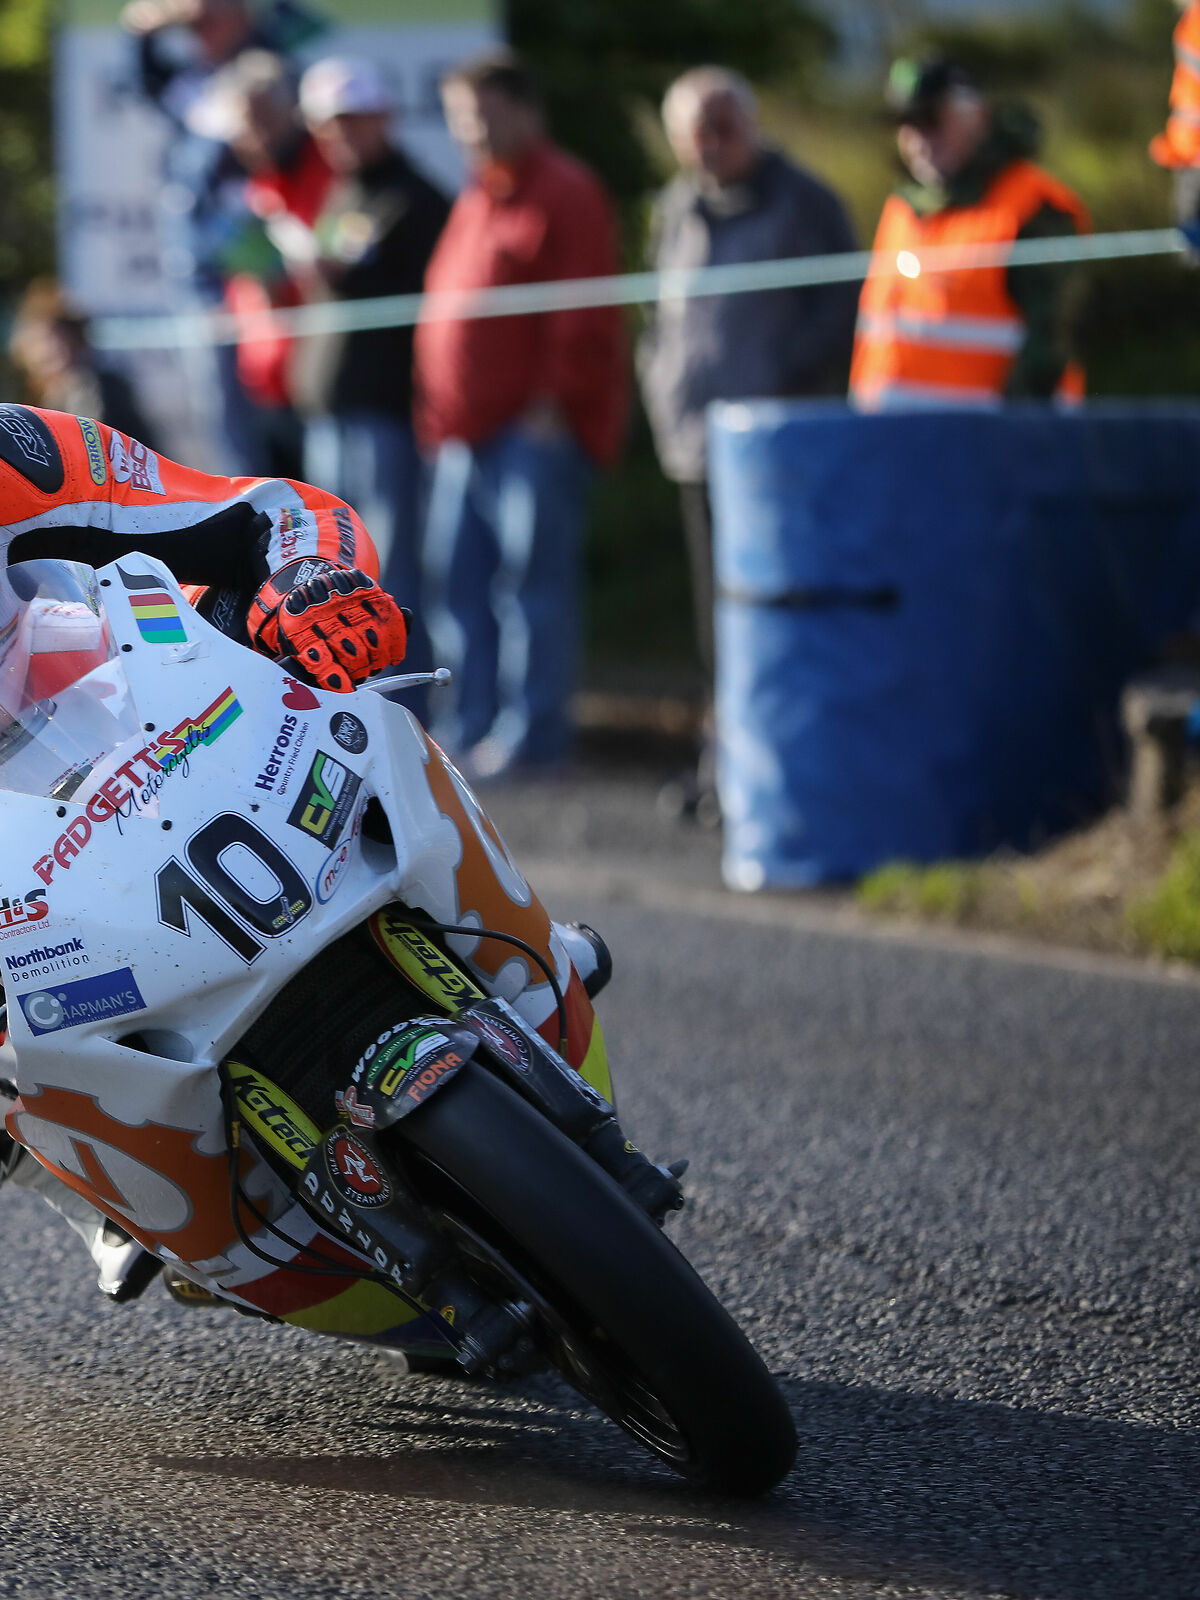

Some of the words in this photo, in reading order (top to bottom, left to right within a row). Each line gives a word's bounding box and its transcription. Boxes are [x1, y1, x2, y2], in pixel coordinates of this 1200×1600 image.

[79, 418, 102, 479] ARROW
[115, 722, 211, 836] Motorcycles
[254, 714, 298, 792] Herrons
[277, 765, 295, 795] Country
[289, 746, 300, 766] Fried
[32, 729, 187, 886] PADGETT'S
[300, 752, 347, 835] CVS
[154, 810, 314, 966] 10
[5, 937, 84, 970] Northbank
[12, 954, 90, 982] Demolition
[408, 1052, 463, 1102] FIONA
[345, 1187, 377, 1204] STEAM
